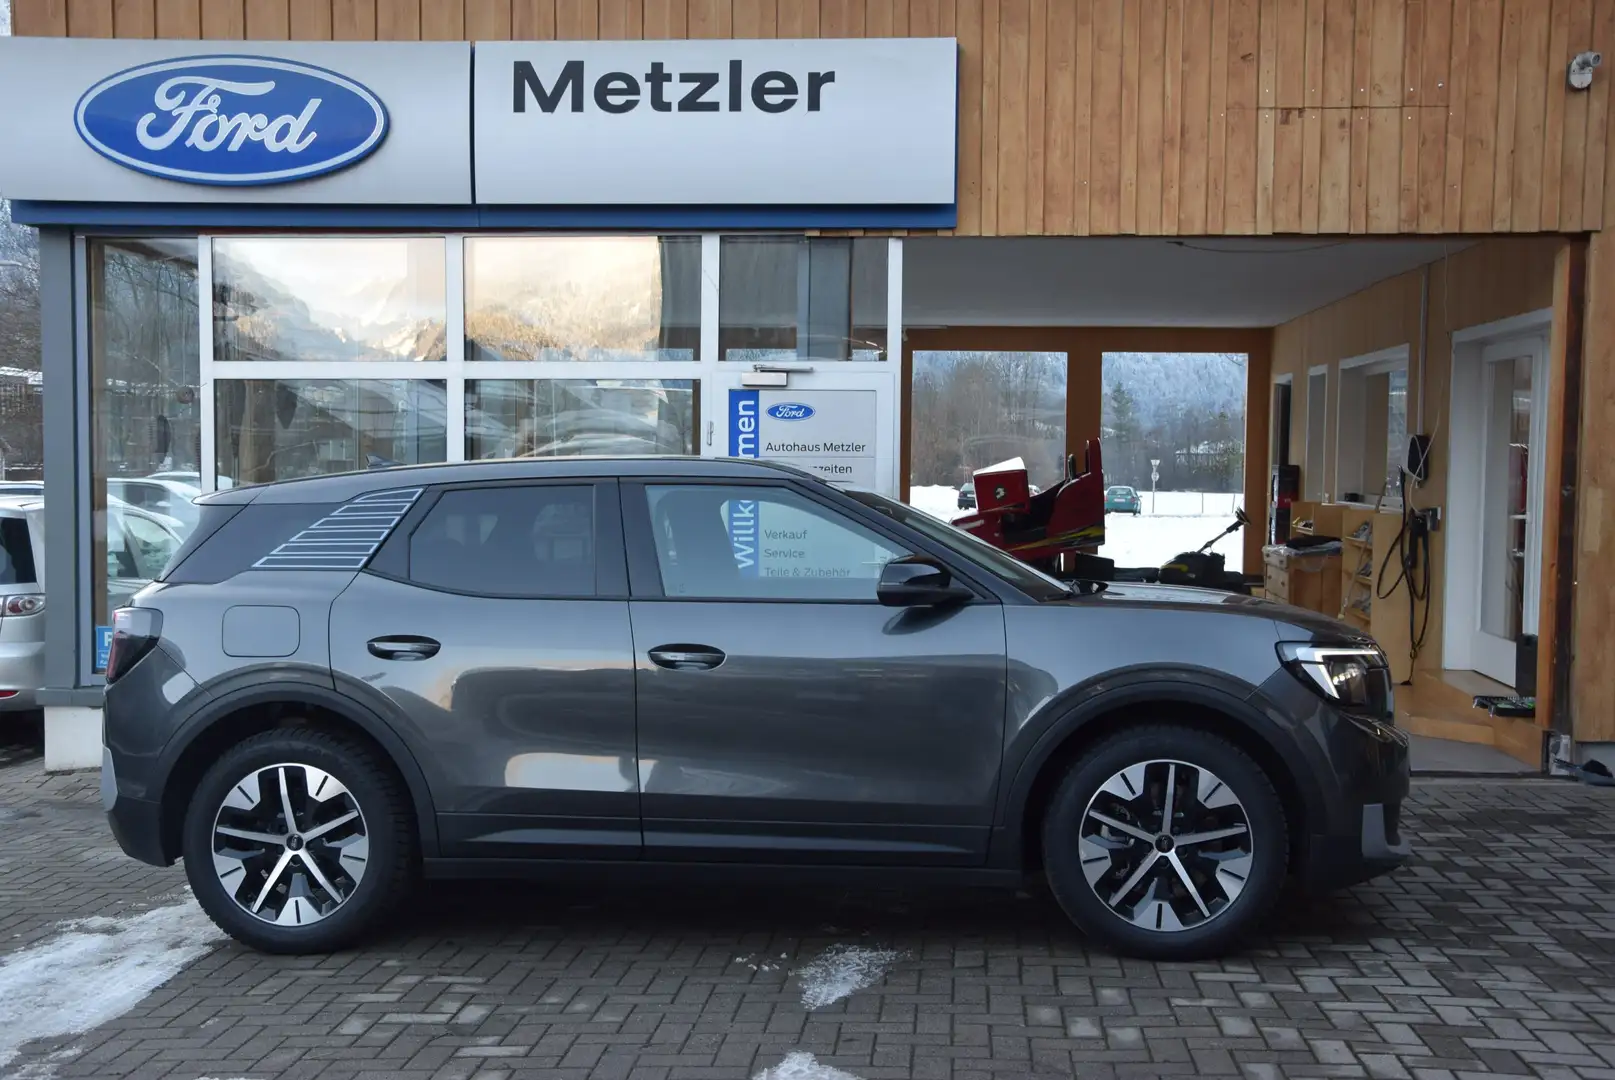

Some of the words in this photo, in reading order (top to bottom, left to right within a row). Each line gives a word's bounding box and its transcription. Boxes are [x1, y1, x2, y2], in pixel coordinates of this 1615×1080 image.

[513, 60, 835, 113] Metzler
[136, 76, 322, 153] Ford
[775, 404, 805, 418] Ford
[766, 442, 821, 452] Autohaus
[823, 442, 866, 452] Metzler
[764, 529, 808, 540] Verkauf
[763, 548, 805, 558] Service
[764, 567, 790, 577] Teile
[792, 567, 801, 577] &
[804, 567, 851, 577] Zubehör
